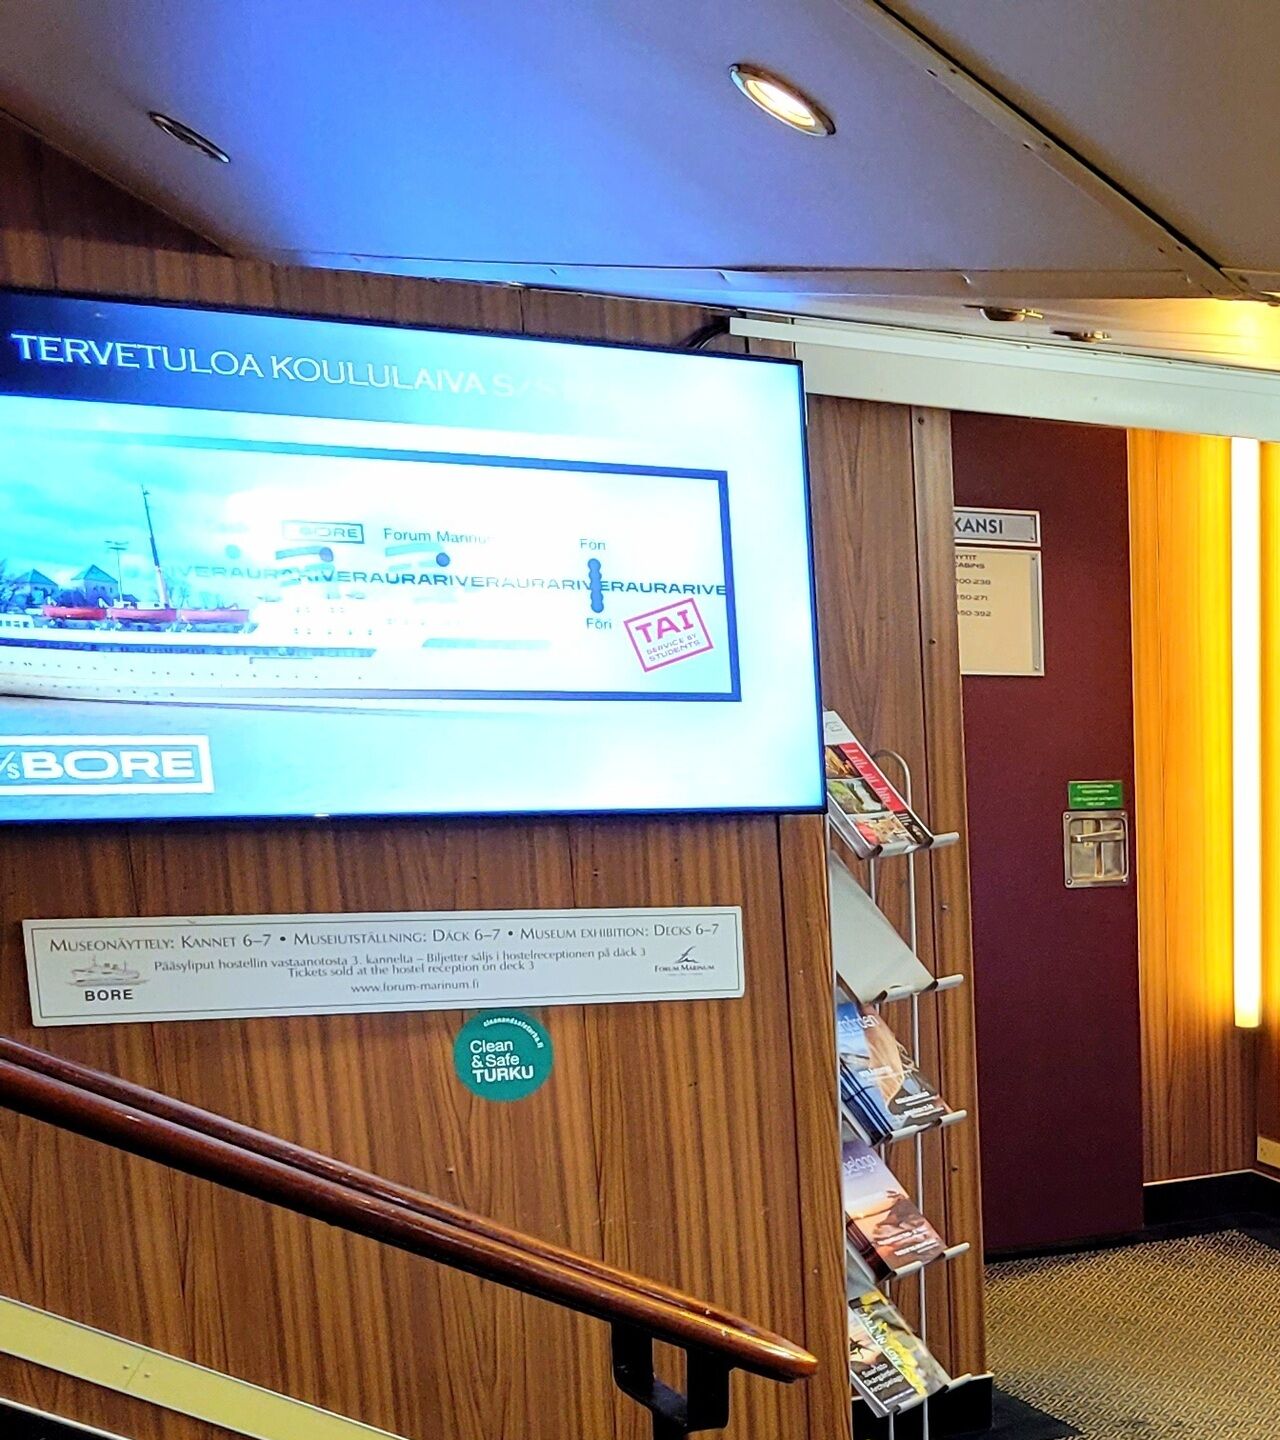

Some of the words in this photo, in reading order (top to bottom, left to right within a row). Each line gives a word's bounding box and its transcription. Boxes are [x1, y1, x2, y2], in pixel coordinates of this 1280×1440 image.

[11, 332, 265, 379] TERVETULOA
[269, 354, 487, 396] KOULULAIVA
[383, 527, 432, 542] Forum
[634, 609, 694, 644] TAI
[21, 749, 196, 779] BORE
[181, 934, 237, 949] KANNET
[520, 926, 577, 941] MUSEUM
[580, 925, 649, 939] EXHIBITION:
[653, 922, 692, 937] DECKS
[153, 960, 215, 975] Pääsyliput
[218, 956, 268, 969] hostellin
[271, 957, 348, 968] vastaanotosta
[366, 953, 414, 965] kannelta
[426, 952, 469, 965] Biljetter
[502, 948, 595, 963] hostelreceptionen
[288, 966, 328, 978] Tickets
[330, 965, 354, 977] sold
[356, 966, 367, 976] at
[370, 963, 389, 975] the
[392, 962, 426, 974] hostel
[428, 961, 480, 974] reception
[482, 962, 497, 973] on
[499, 959, 527, 971] deck
[84, 988, 134, 1002] BORE
[350, 979, 480, 994] www.forum-marinum.fi
[469, 1039, 514, 1054] Clean
[471, 1054, 484, 1069] &
[485, 1053, 520, 1068] Safe
[472, 1065, 534, 1084] TURKU
